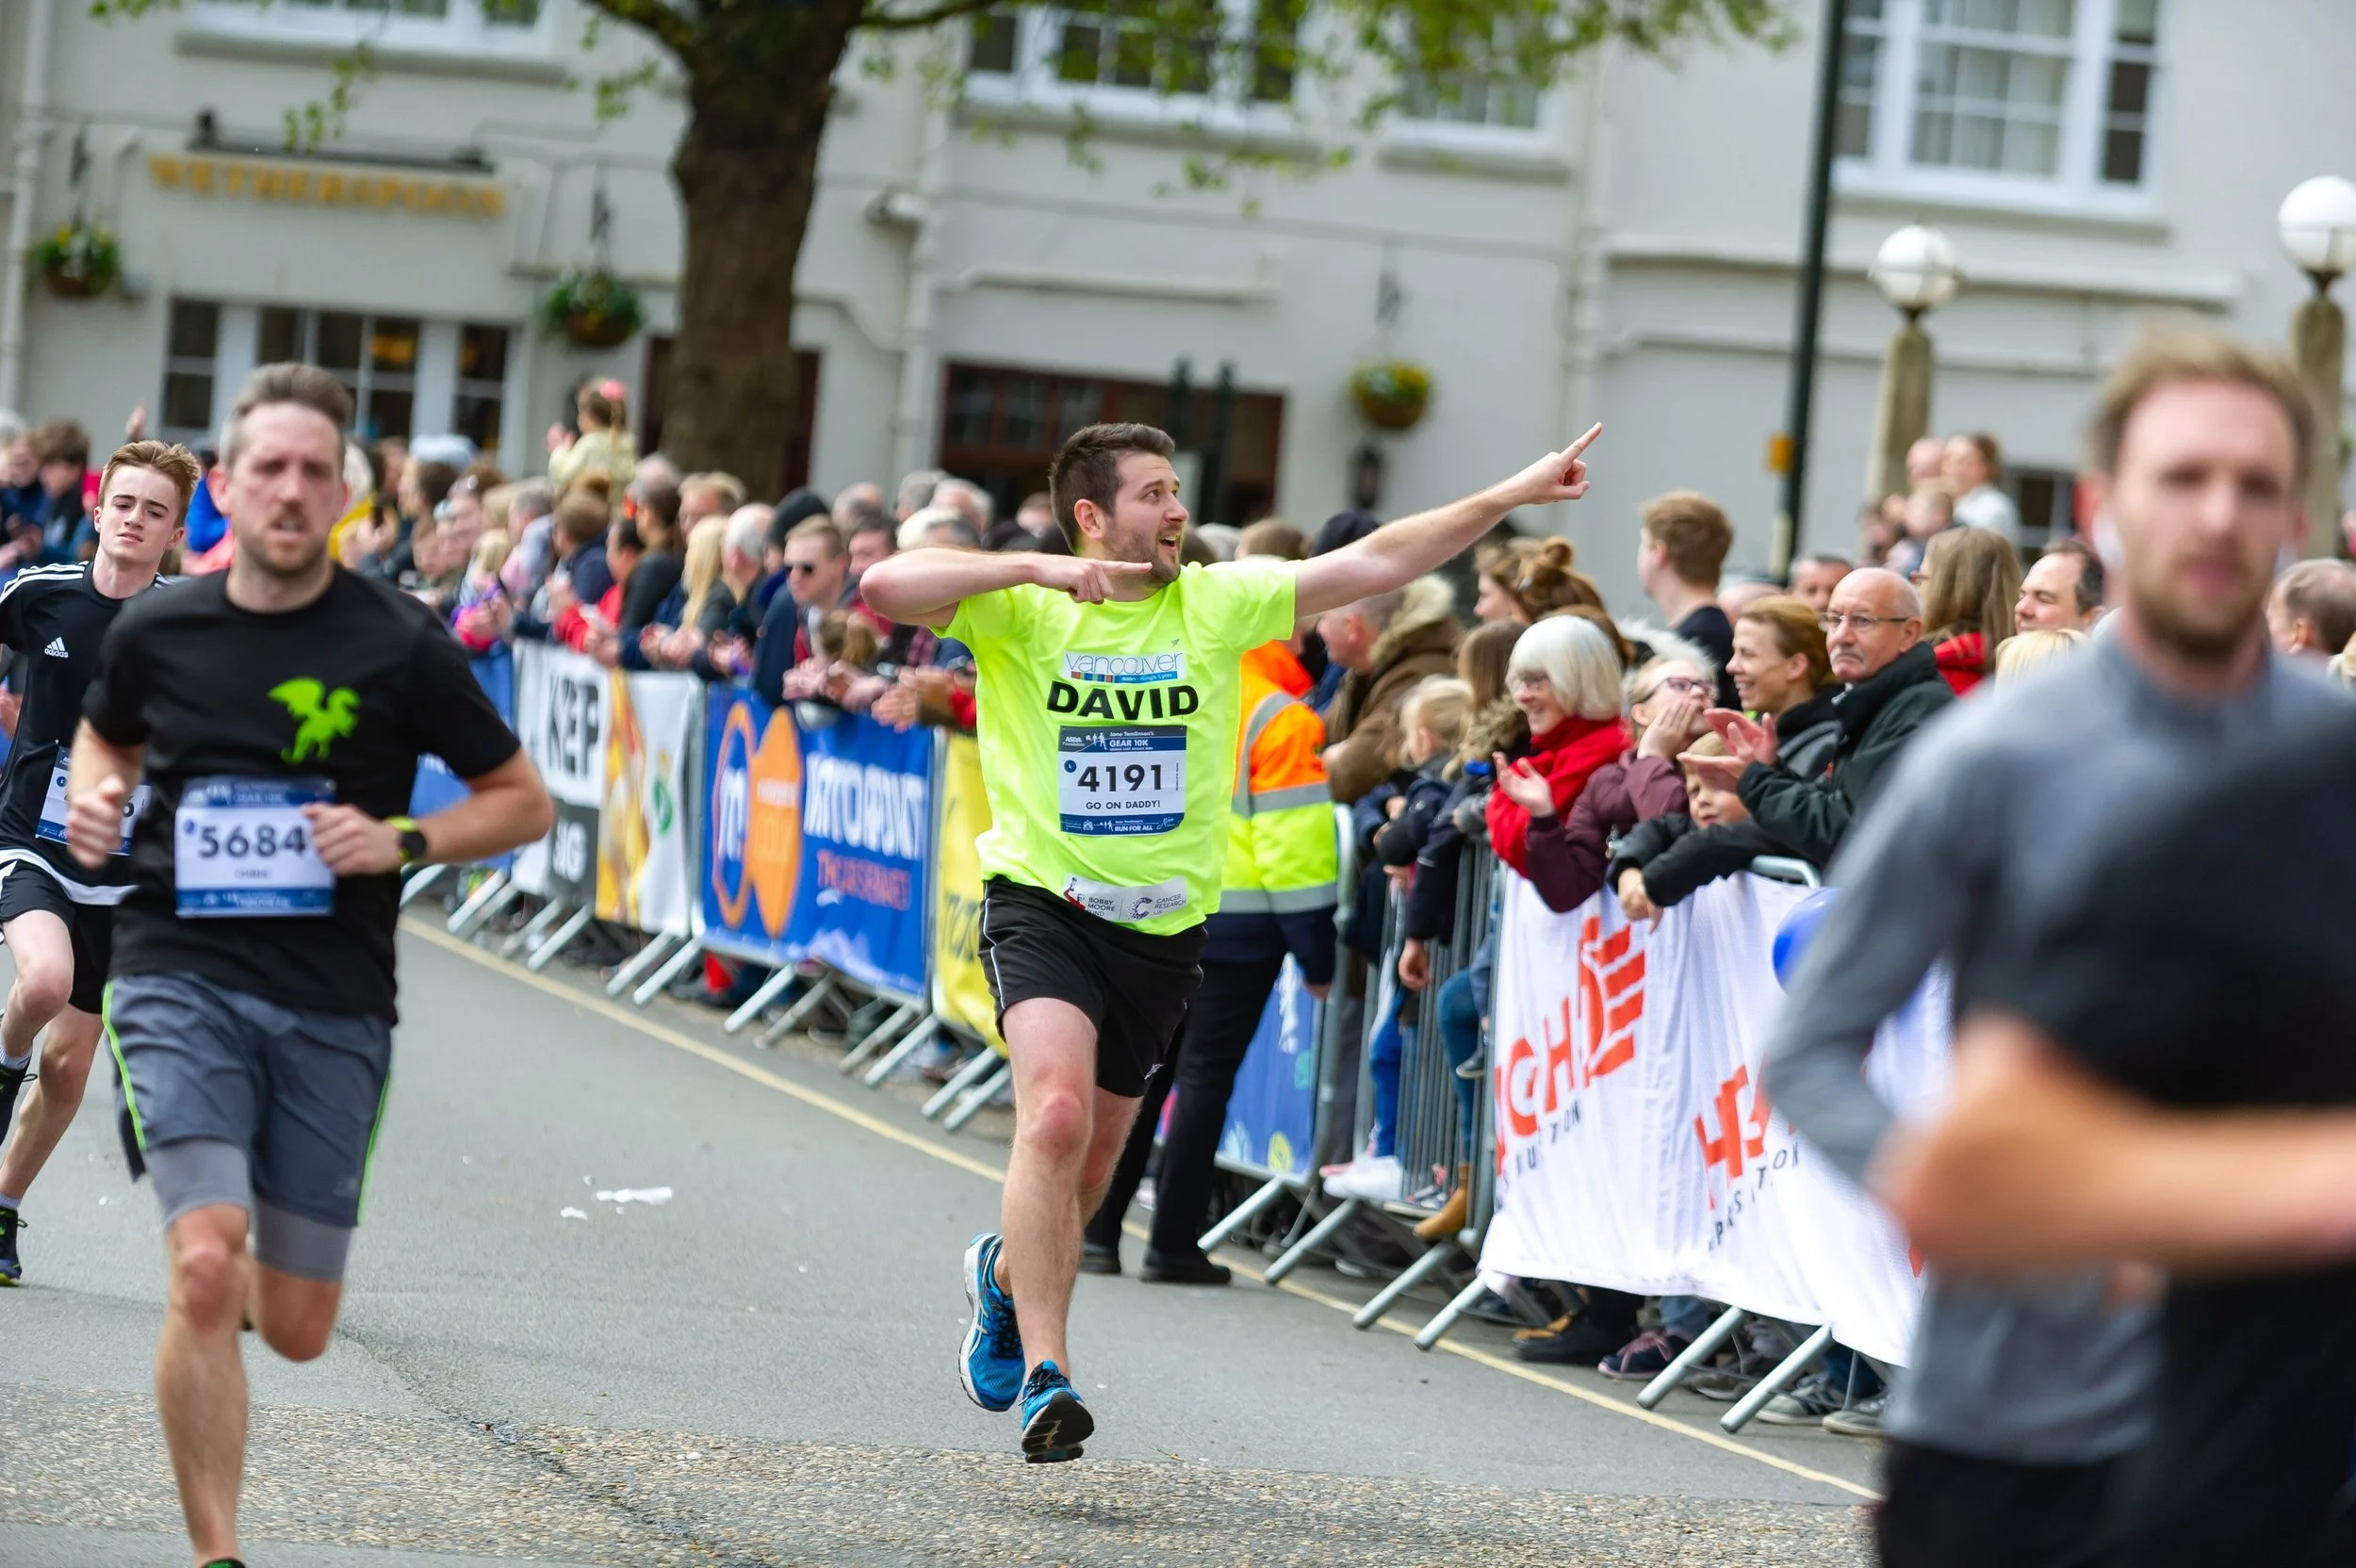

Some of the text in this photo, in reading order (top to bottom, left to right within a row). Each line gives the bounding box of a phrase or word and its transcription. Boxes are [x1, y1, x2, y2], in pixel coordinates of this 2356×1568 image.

[43, 647, 69, 659] adidas
[1065, 652, 1183, 675] vancouver
[1046, 680, 1199, 721] DAVID
[1134, 739, 1149, 747] 10K
[1077, 763, 1162, 792] 4191
[1086, 799, 1161, 809] GO ON DADDY!
[199, 825, 306, 858] 5684
[1088, 896, 1114, 906] BOBBY
[1153, 898, 1186, 910] RESEARCH
[1155, 894, 1182, 905] CANCER
[1087, 904, 1116, 912] MOORE
